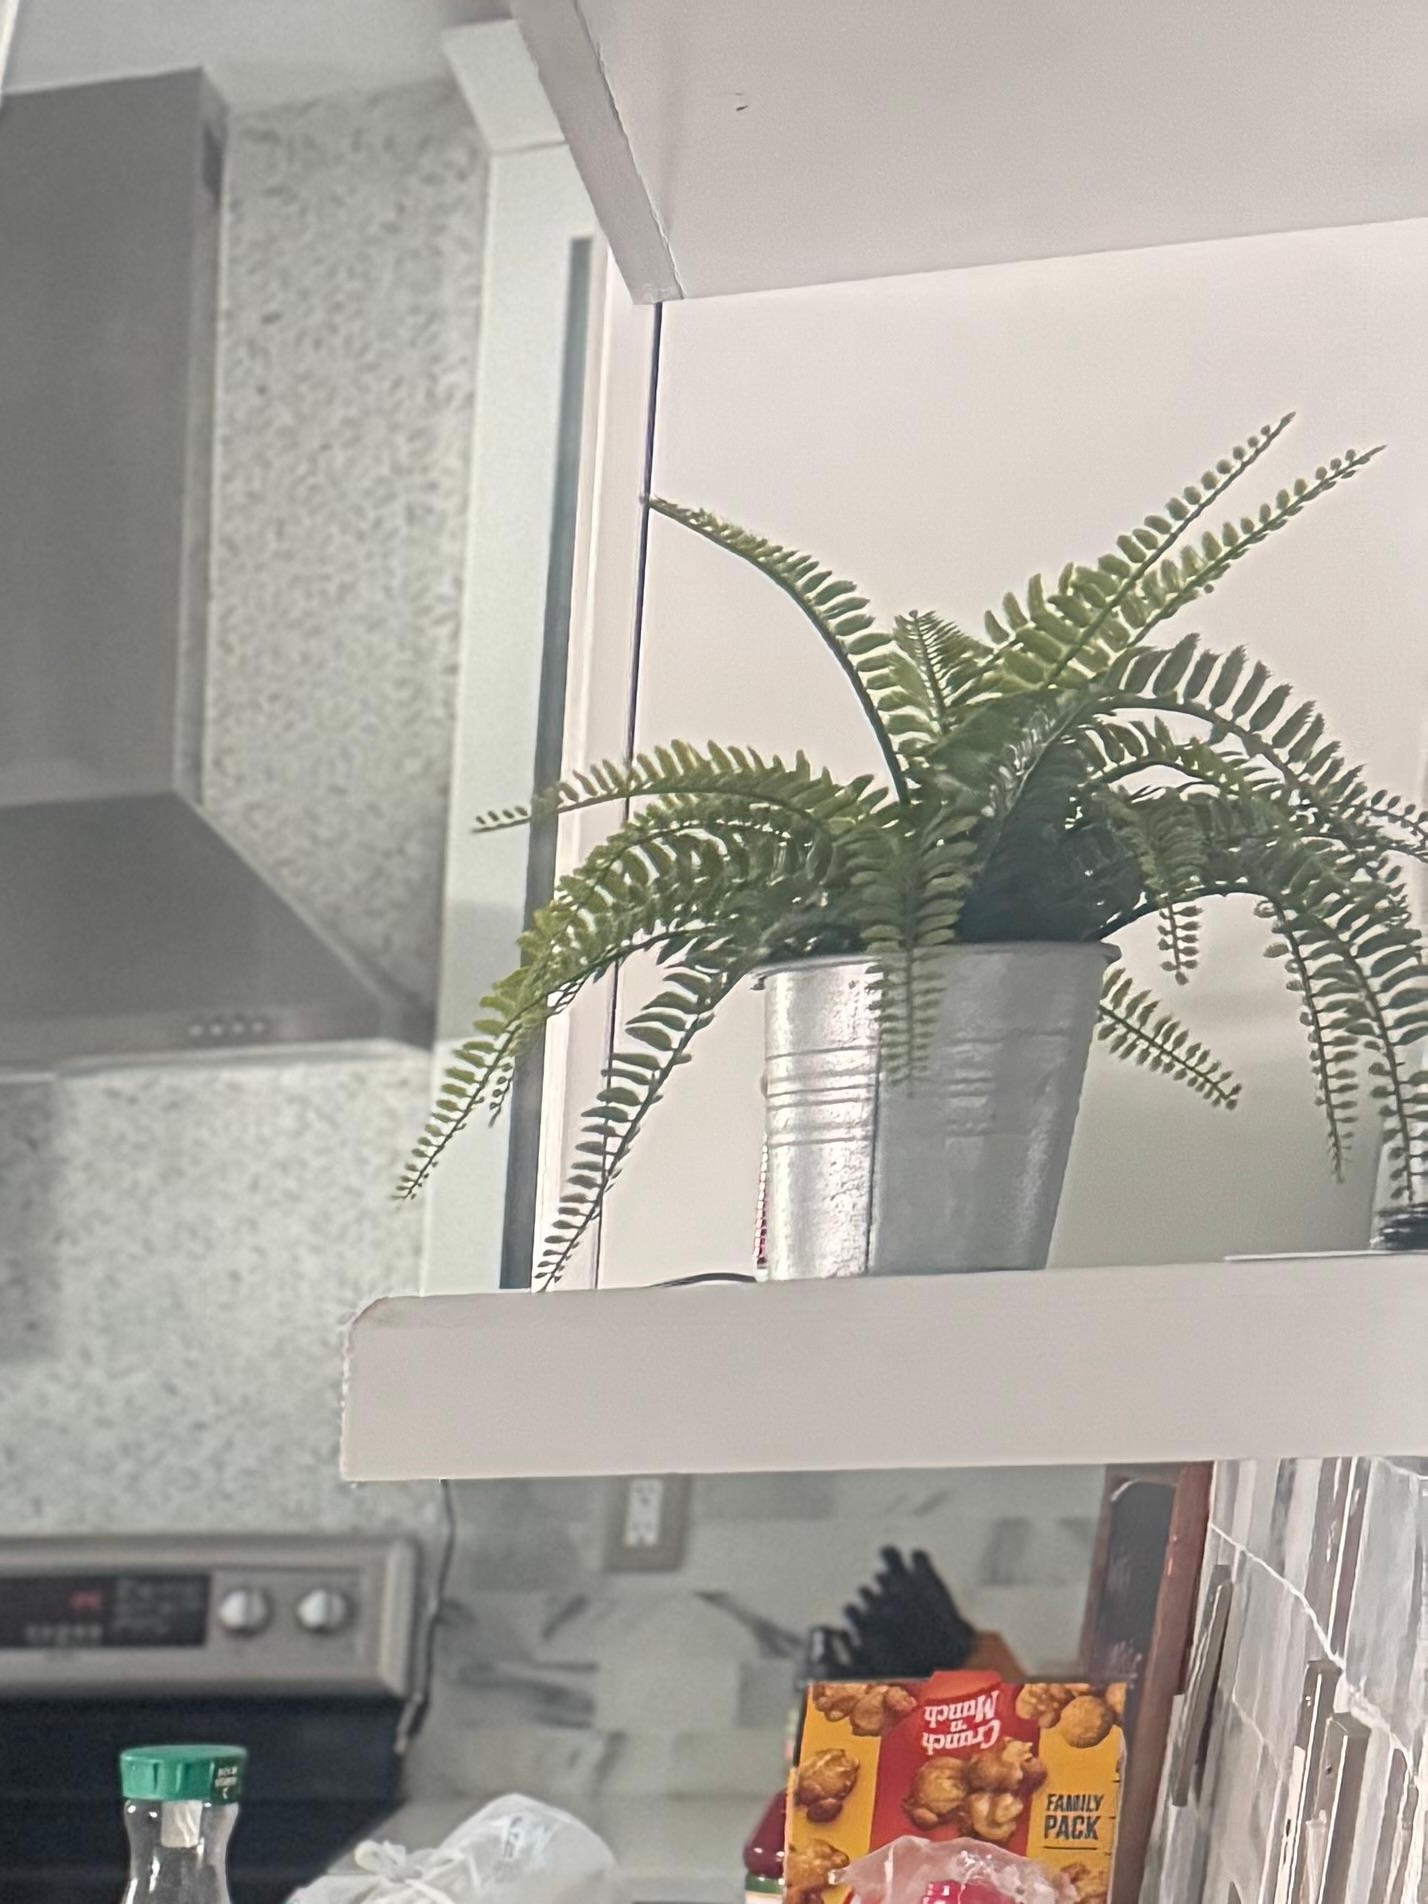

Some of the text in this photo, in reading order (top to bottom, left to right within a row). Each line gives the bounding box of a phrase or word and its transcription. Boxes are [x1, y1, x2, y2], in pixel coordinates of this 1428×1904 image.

[924, 1690, 1000, 1728] Munch
[922, 1719, 1001, 1755] Crunch
[1045, 1793, 1104, 1813] FAMILY
[1044, 1814, 1101, 1841] PACK
